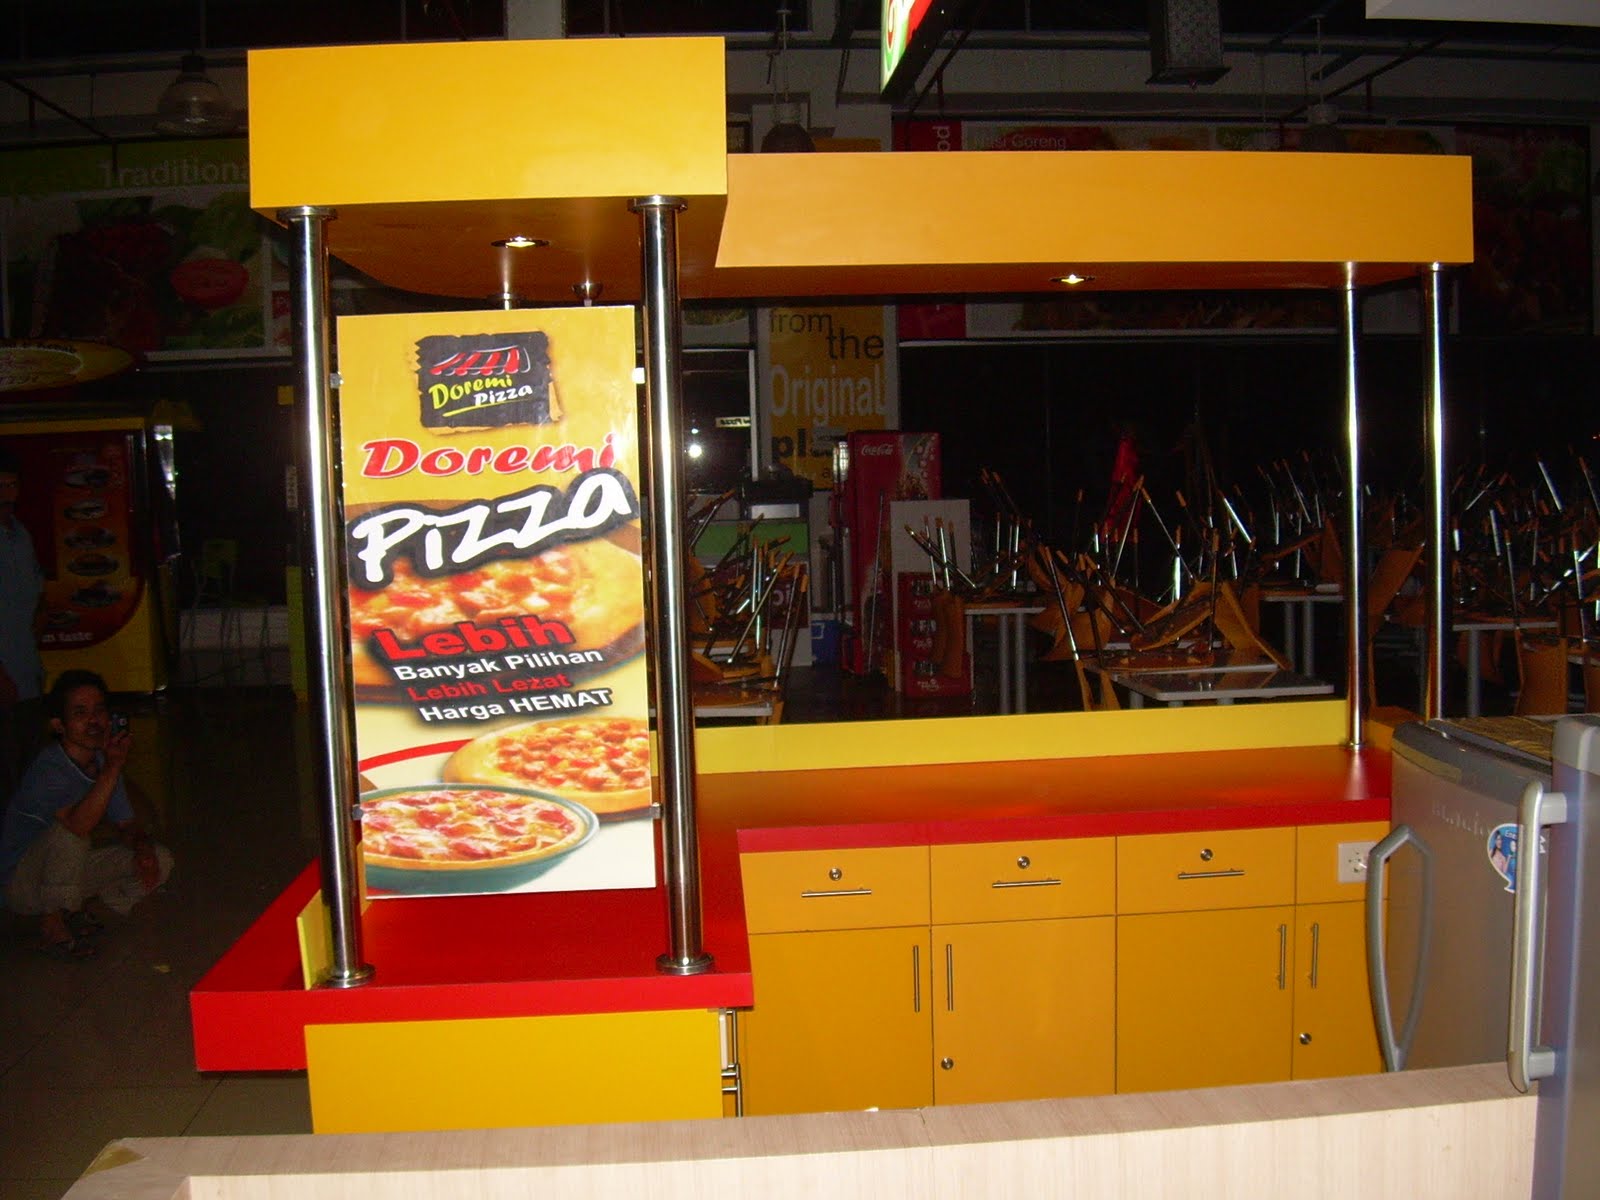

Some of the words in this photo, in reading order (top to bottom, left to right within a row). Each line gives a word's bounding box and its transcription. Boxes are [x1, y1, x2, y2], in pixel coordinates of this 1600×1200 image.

[1012, 134, 1066, 150] Goreng
[826, 326, 884, 361] the
[428, 374, 513, 410] Doremi
[771, 363, 886, 427] Original
[361, 433, 616, 478] Doremi
[373, 615, 577, 661] Lebih
[393, 658, 501, 681] Banyak
[504, 650, 603, 673] Pilihan
[407, 680, 487, 702] Lebih
[492, 672, 572, 695] Lezat
[418, 702, 505, 723] Harga
[508, 689, 612, 714] HEMAT
